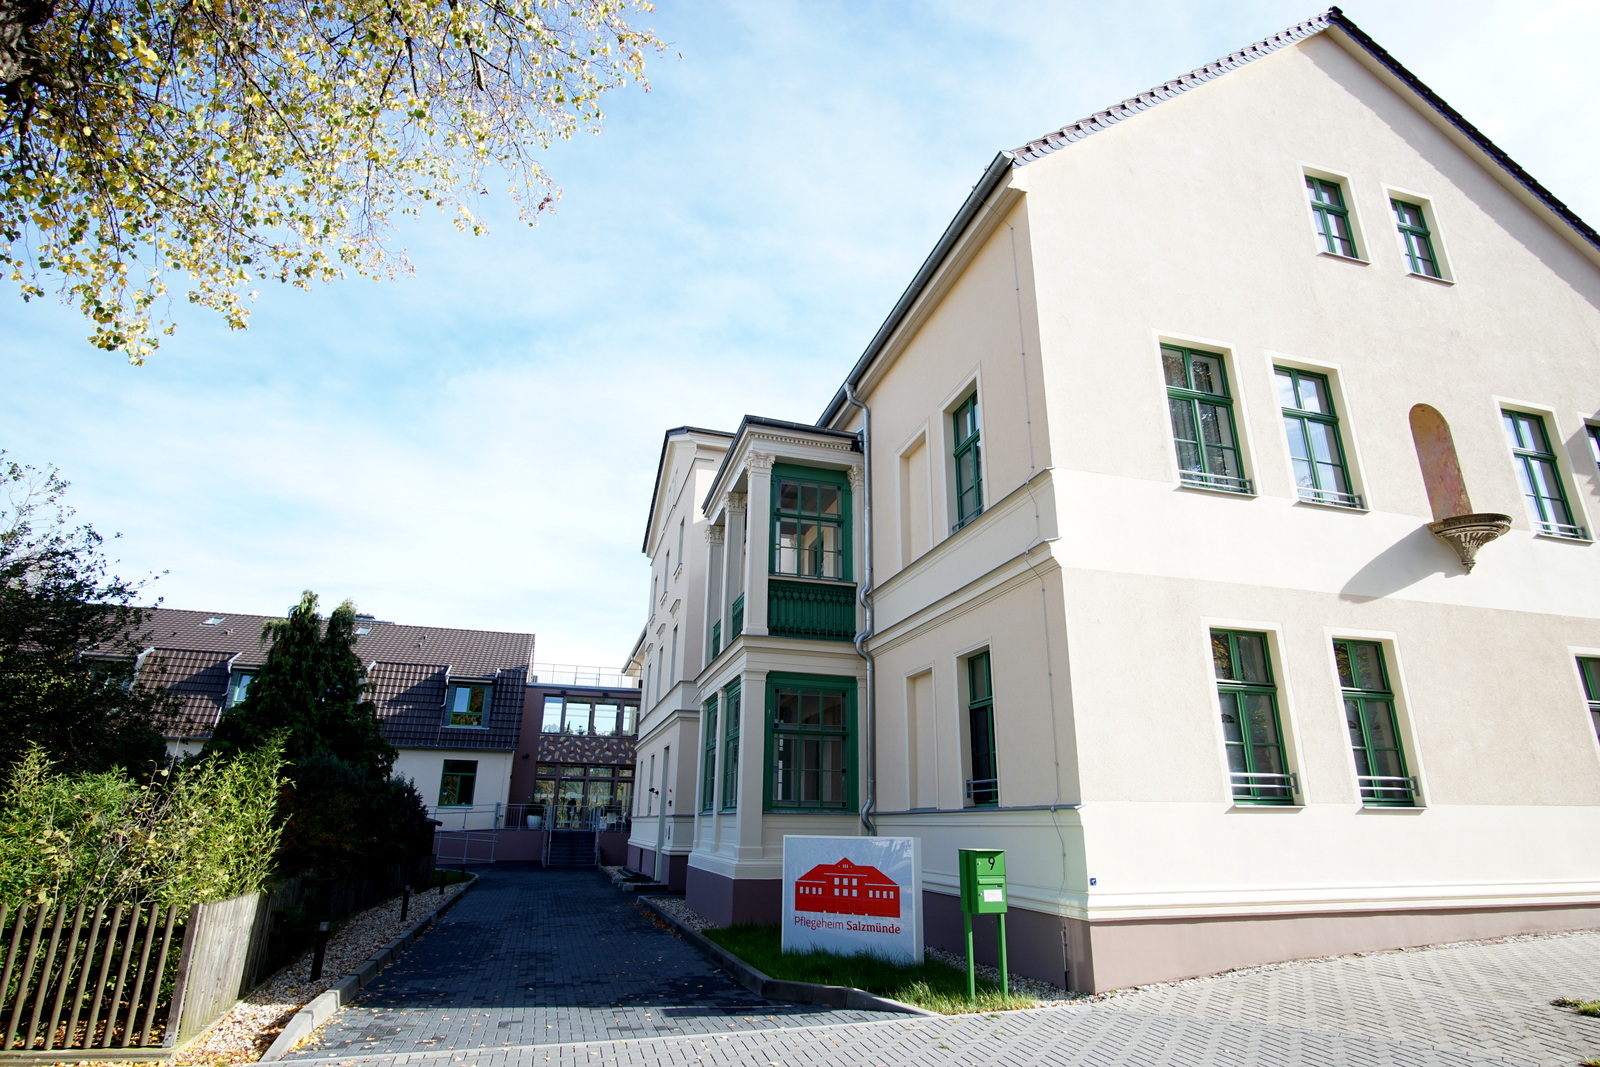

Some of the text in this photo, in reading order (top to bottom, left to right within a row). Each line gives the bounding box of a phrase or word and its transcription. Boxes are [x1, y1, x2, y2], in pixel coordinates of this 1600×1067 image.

[988, 856, 996, 870] 9
[794, 916, 901, 934] Pflegeheim Salzmünde
